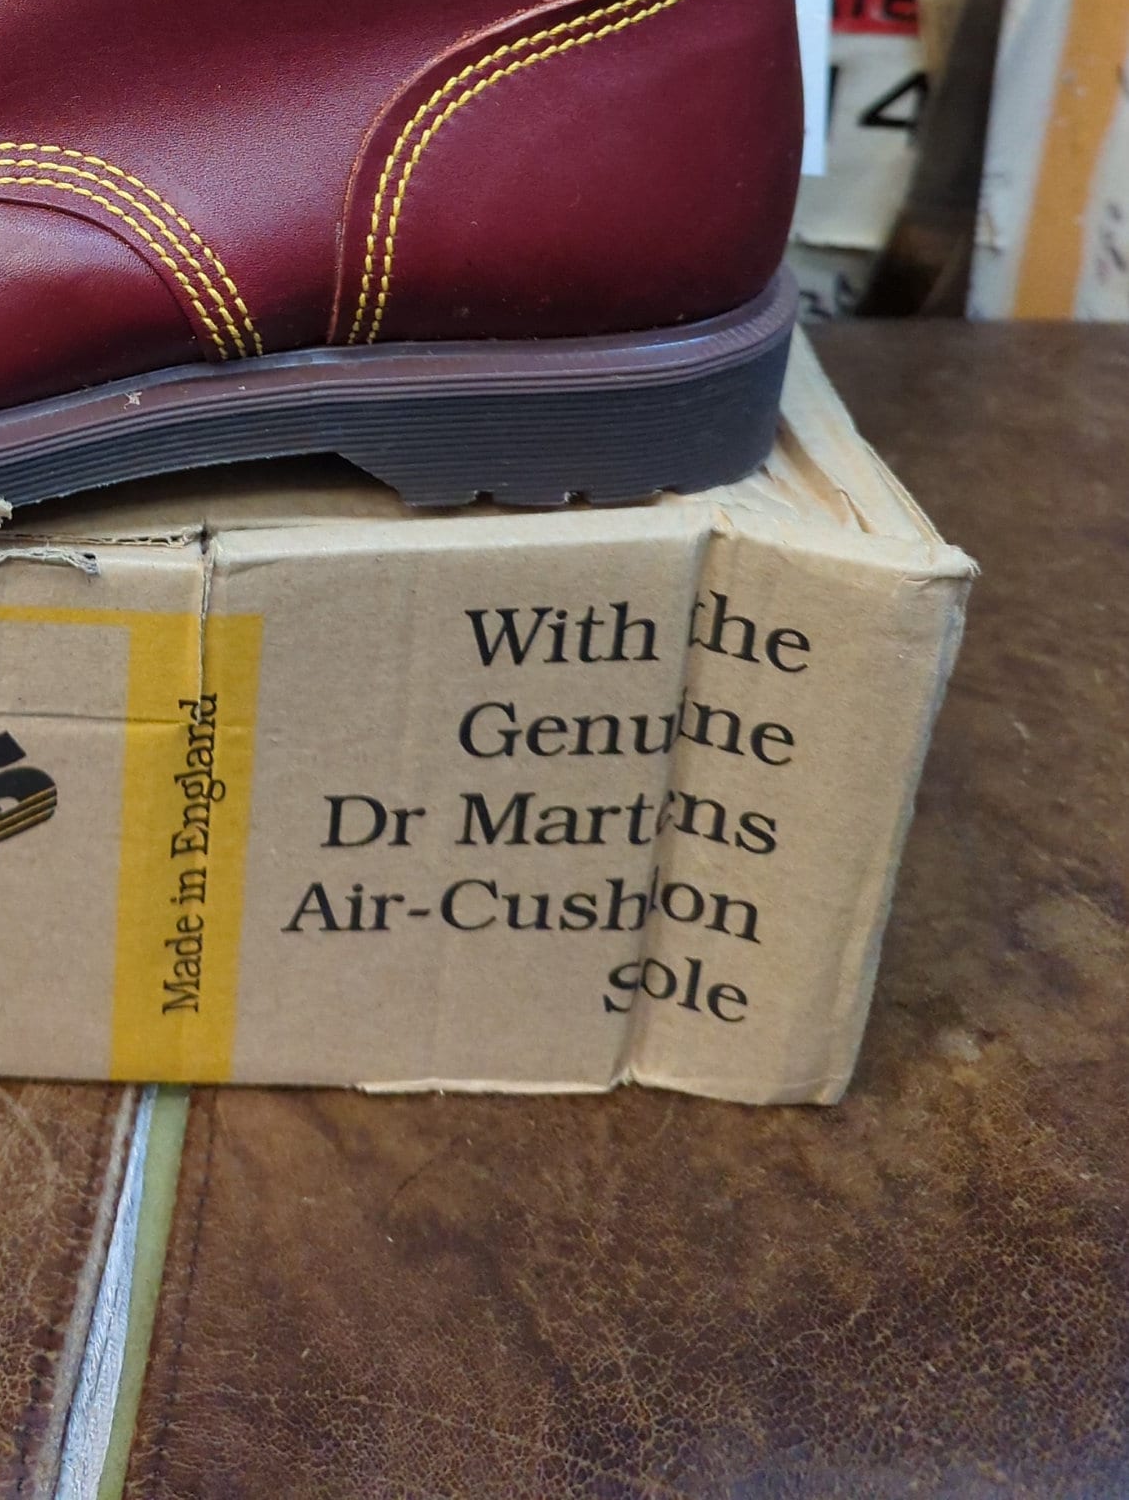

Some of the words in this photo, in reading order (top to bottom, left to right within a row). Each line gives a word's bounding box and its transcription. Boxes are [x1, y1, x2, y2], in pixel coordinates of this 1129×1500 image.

[464, 601, 660, 667] With
[688, 589, 811, 673] the
[171, 692, 226, 860] England
[320, 794, 426, 848] Dr
[170, 866, 207, 906] in
[162, 913, 204, 1016] Made
